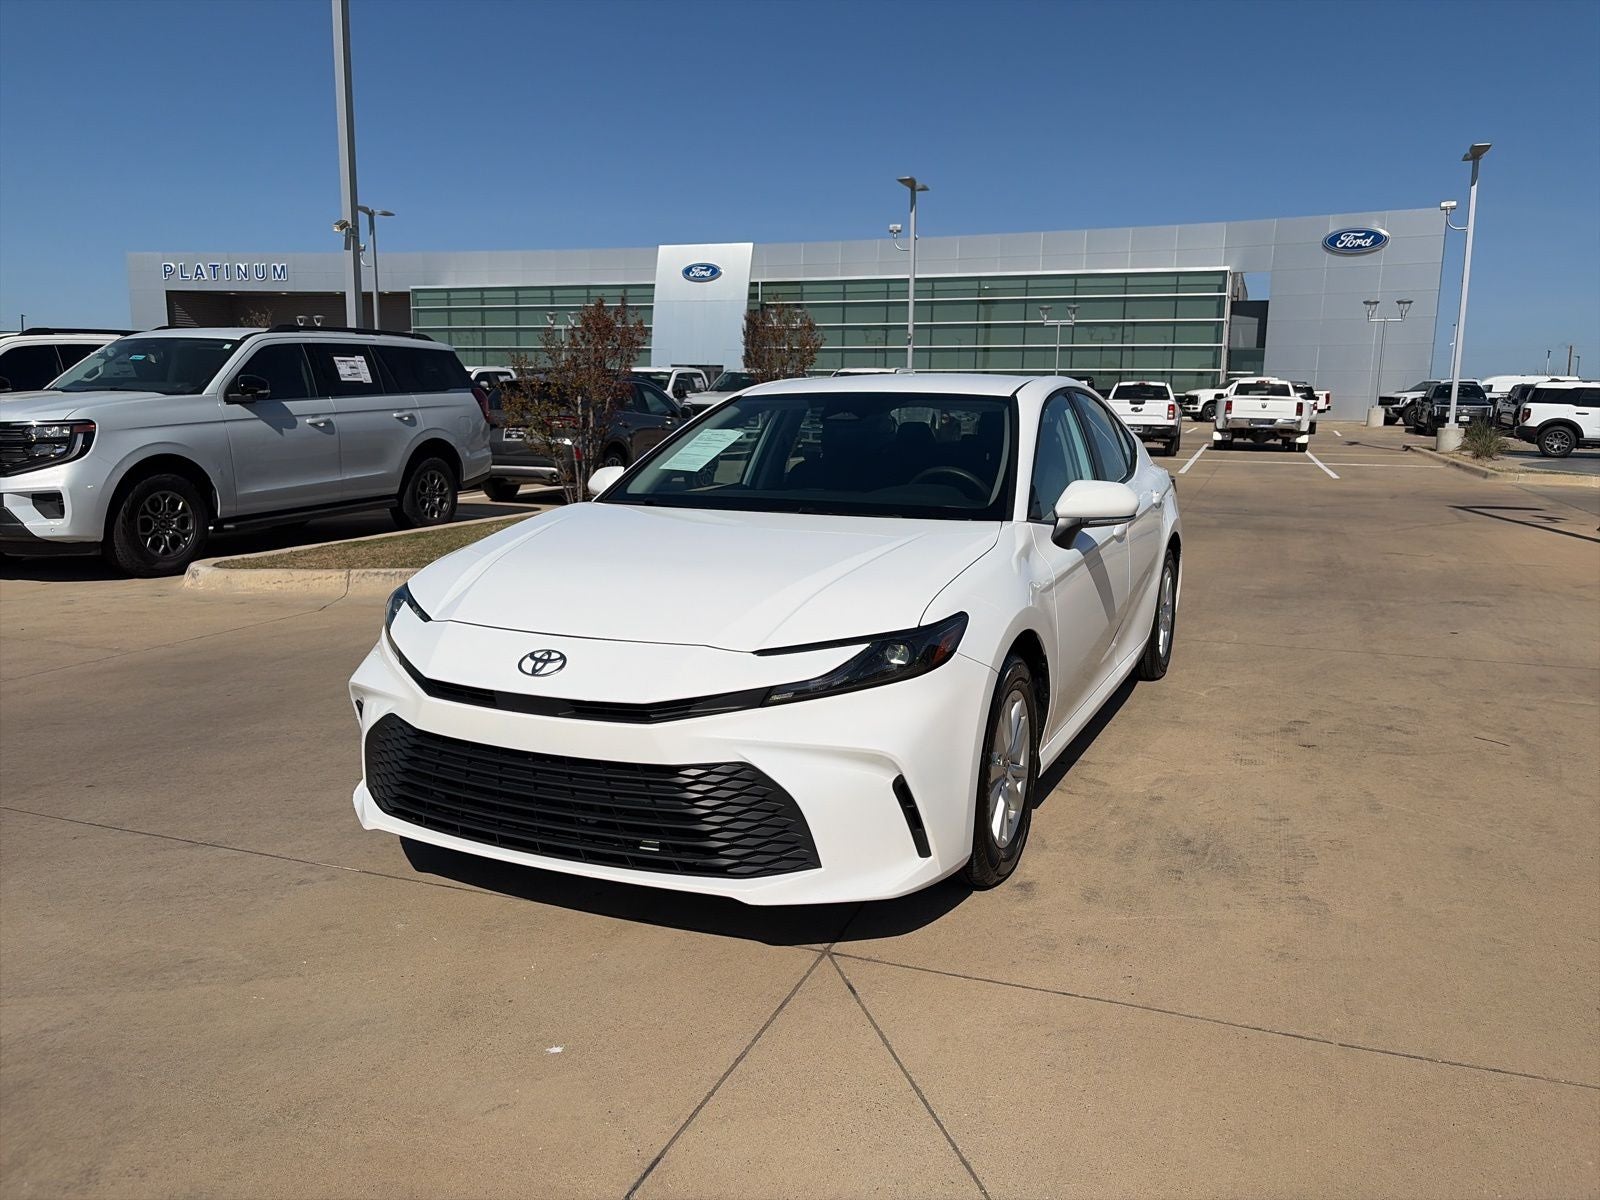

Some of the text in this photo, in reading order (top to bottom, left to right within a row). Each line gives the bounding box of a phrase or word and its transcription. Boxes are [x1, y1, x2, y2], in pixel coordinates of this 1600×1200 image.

[1336, 232, 1375, 248] Ford
[162, 262, 288, 281] PLATINUM
[689, 266, 713, 277] Ford
